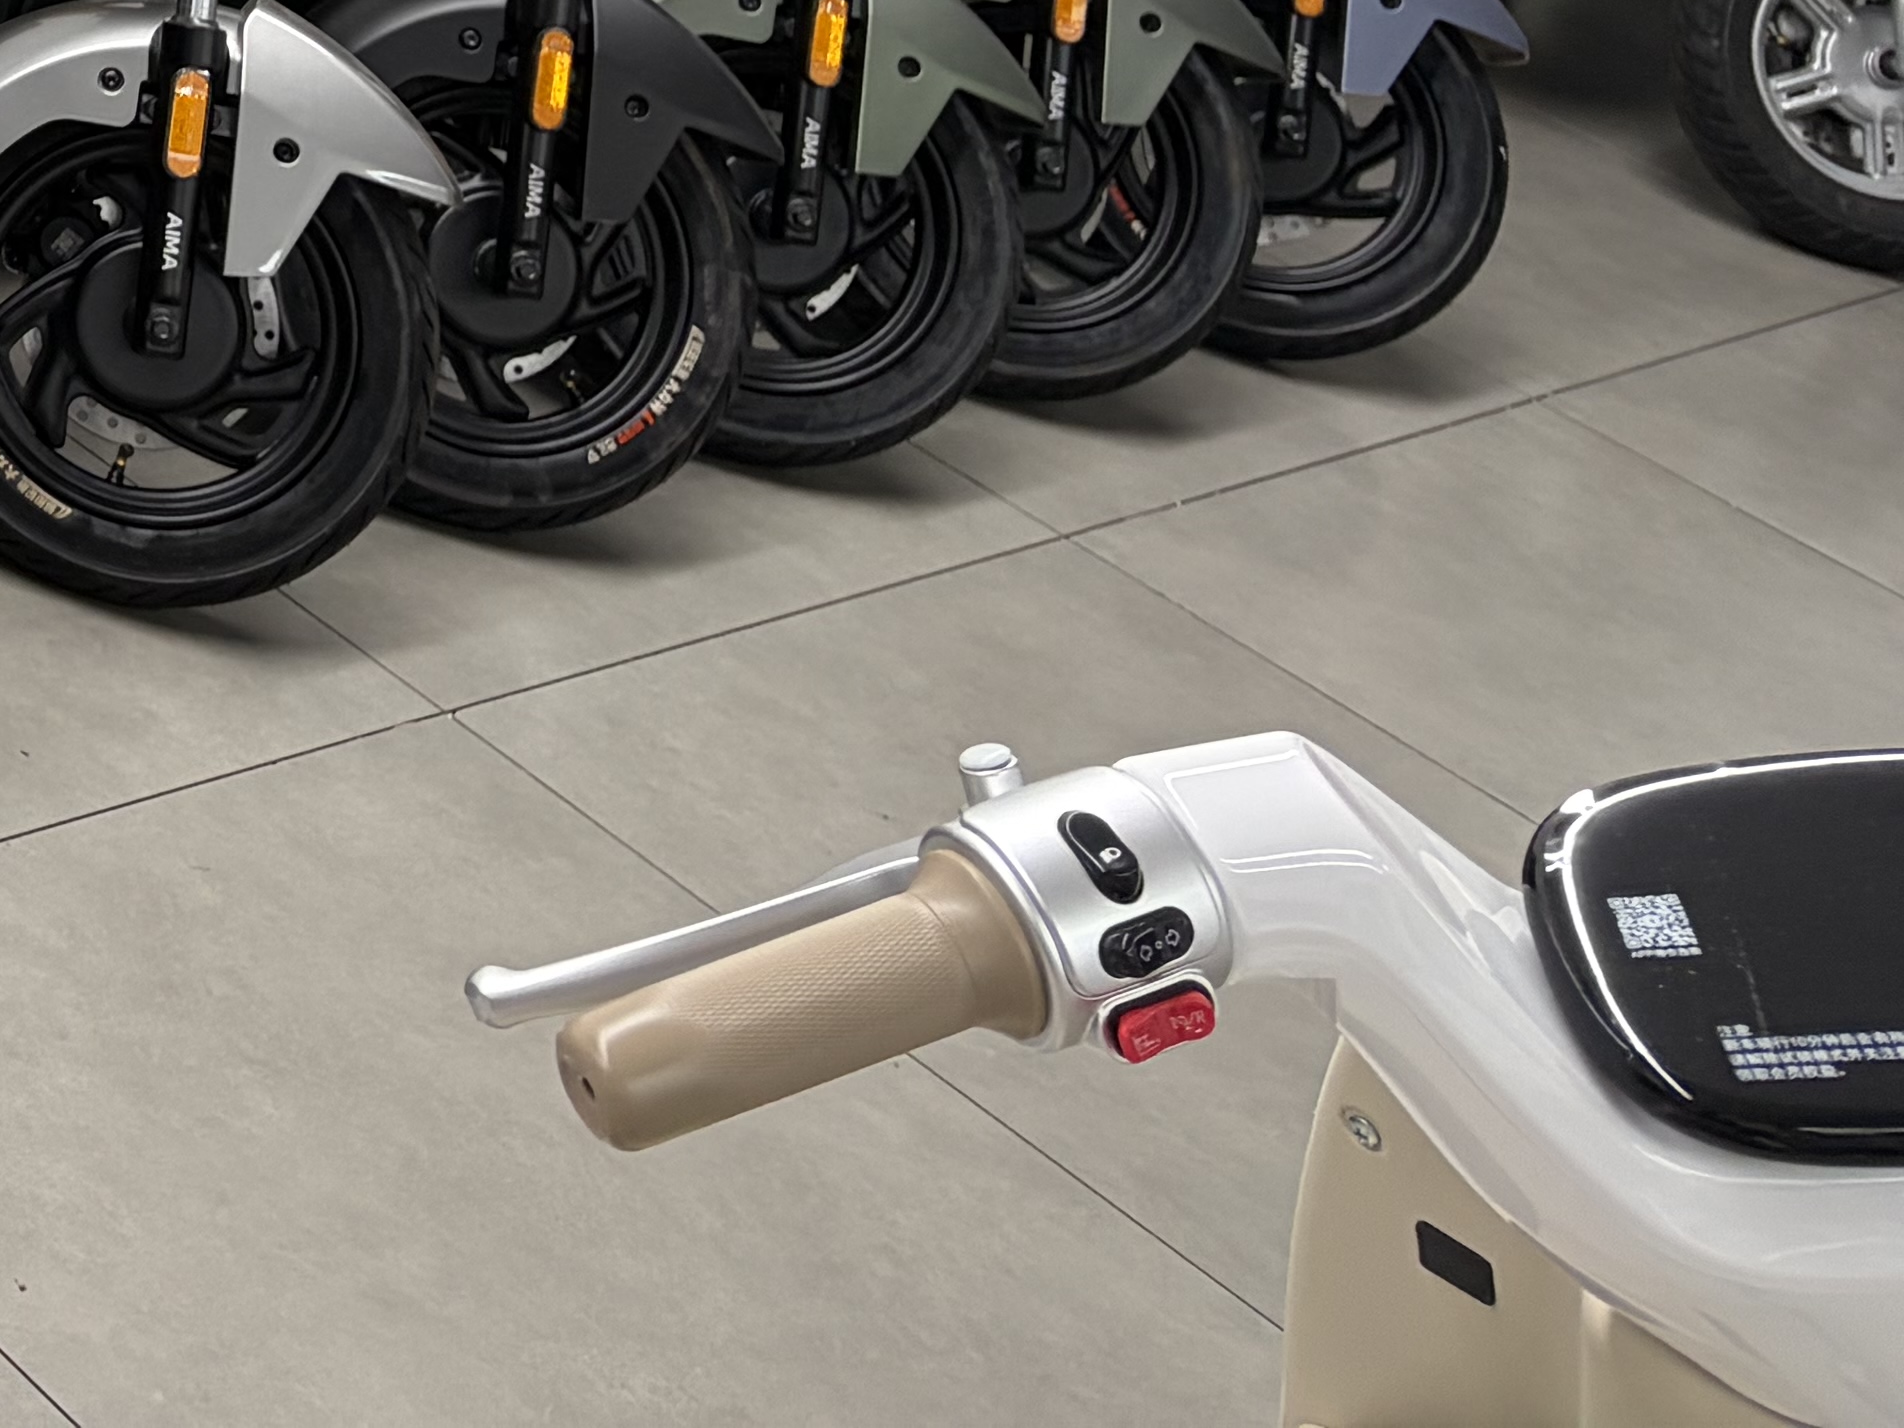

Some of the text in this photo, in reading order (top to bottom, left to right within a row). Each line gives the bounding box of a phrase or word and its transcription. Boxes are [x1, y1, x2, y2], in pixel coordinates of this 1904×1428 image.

[1048, 70, 1067, 121] AIMA
[800, 116, 821, 170] AIMA
[524, 163, 545, 218] AIMA
[161, 211, 183, 271] AIMA
